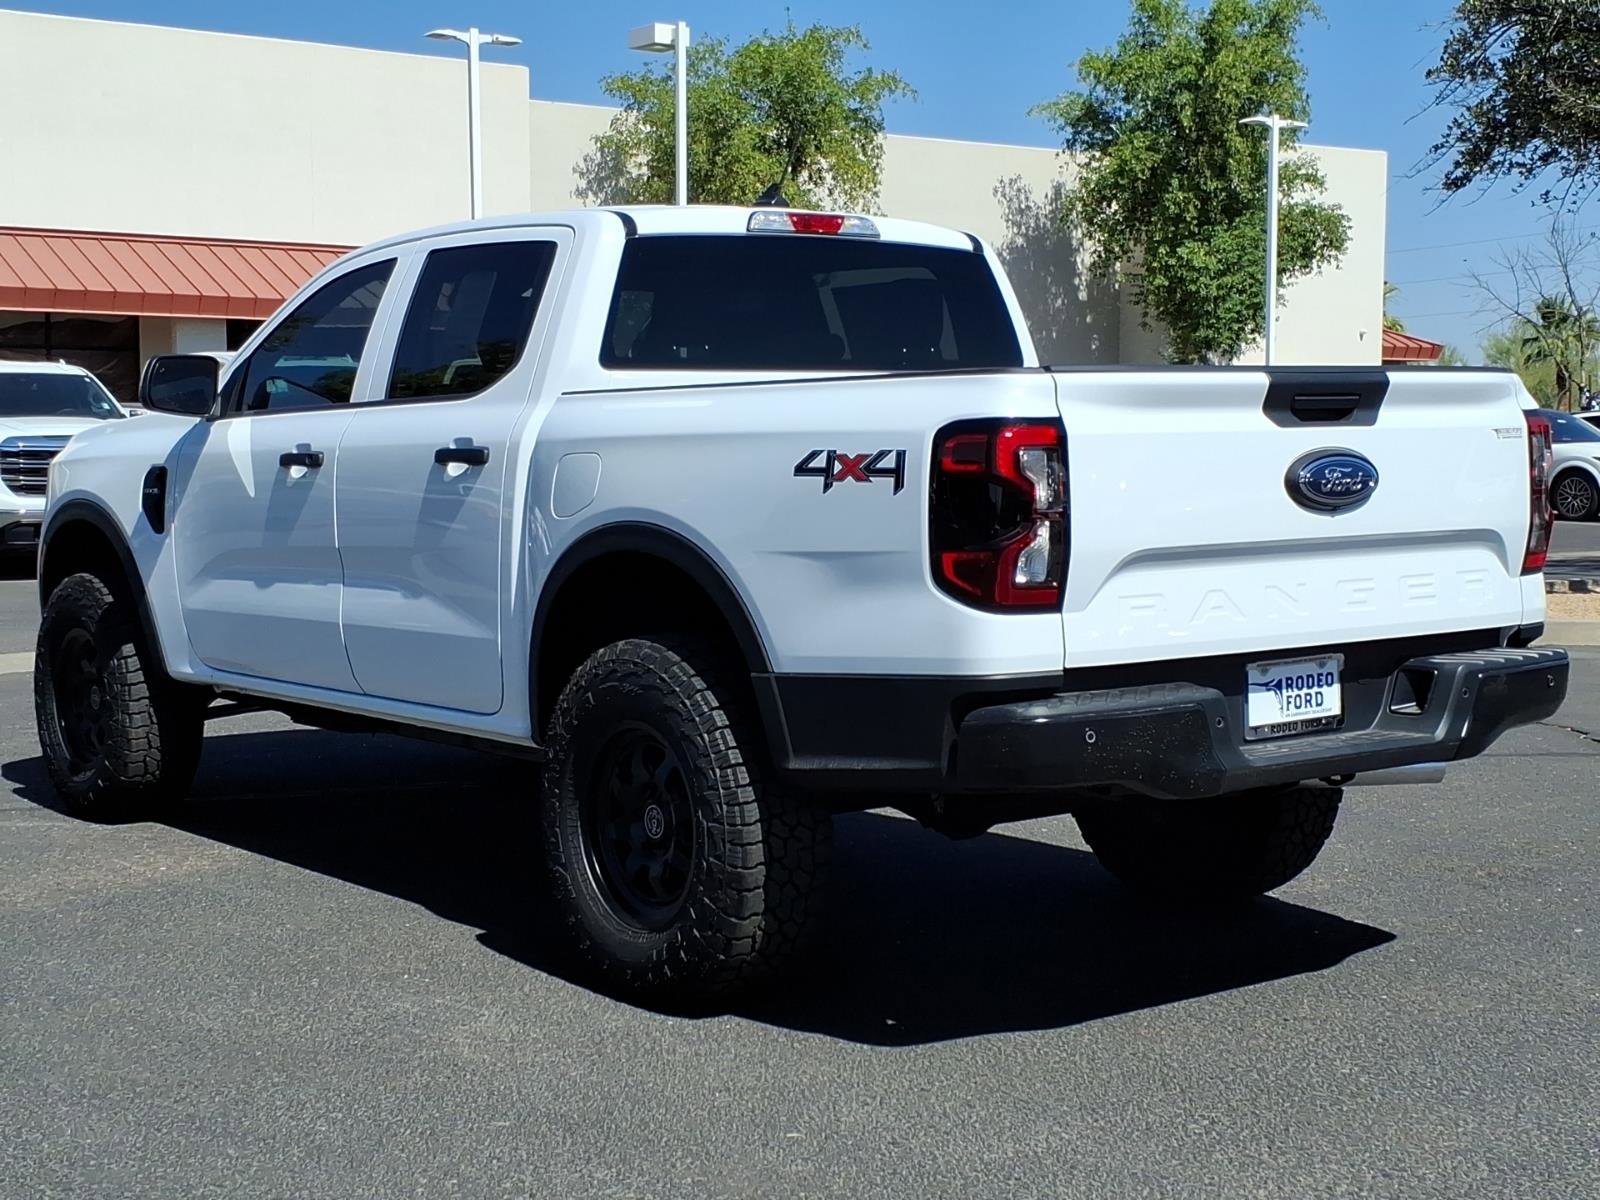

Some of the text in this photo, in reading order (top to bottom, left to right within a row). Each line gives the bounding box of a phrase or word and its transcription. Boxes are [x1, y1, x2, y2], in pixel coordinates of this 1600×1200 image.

[794, 449, 907, 496] 4x4
[1321, 467, 1363, 493] Ford
[1117, 569, 1493, 635] RANGER
[1285, 672, 1334, 693] RODEO
[1286, 691, 1324, 711] FORD
